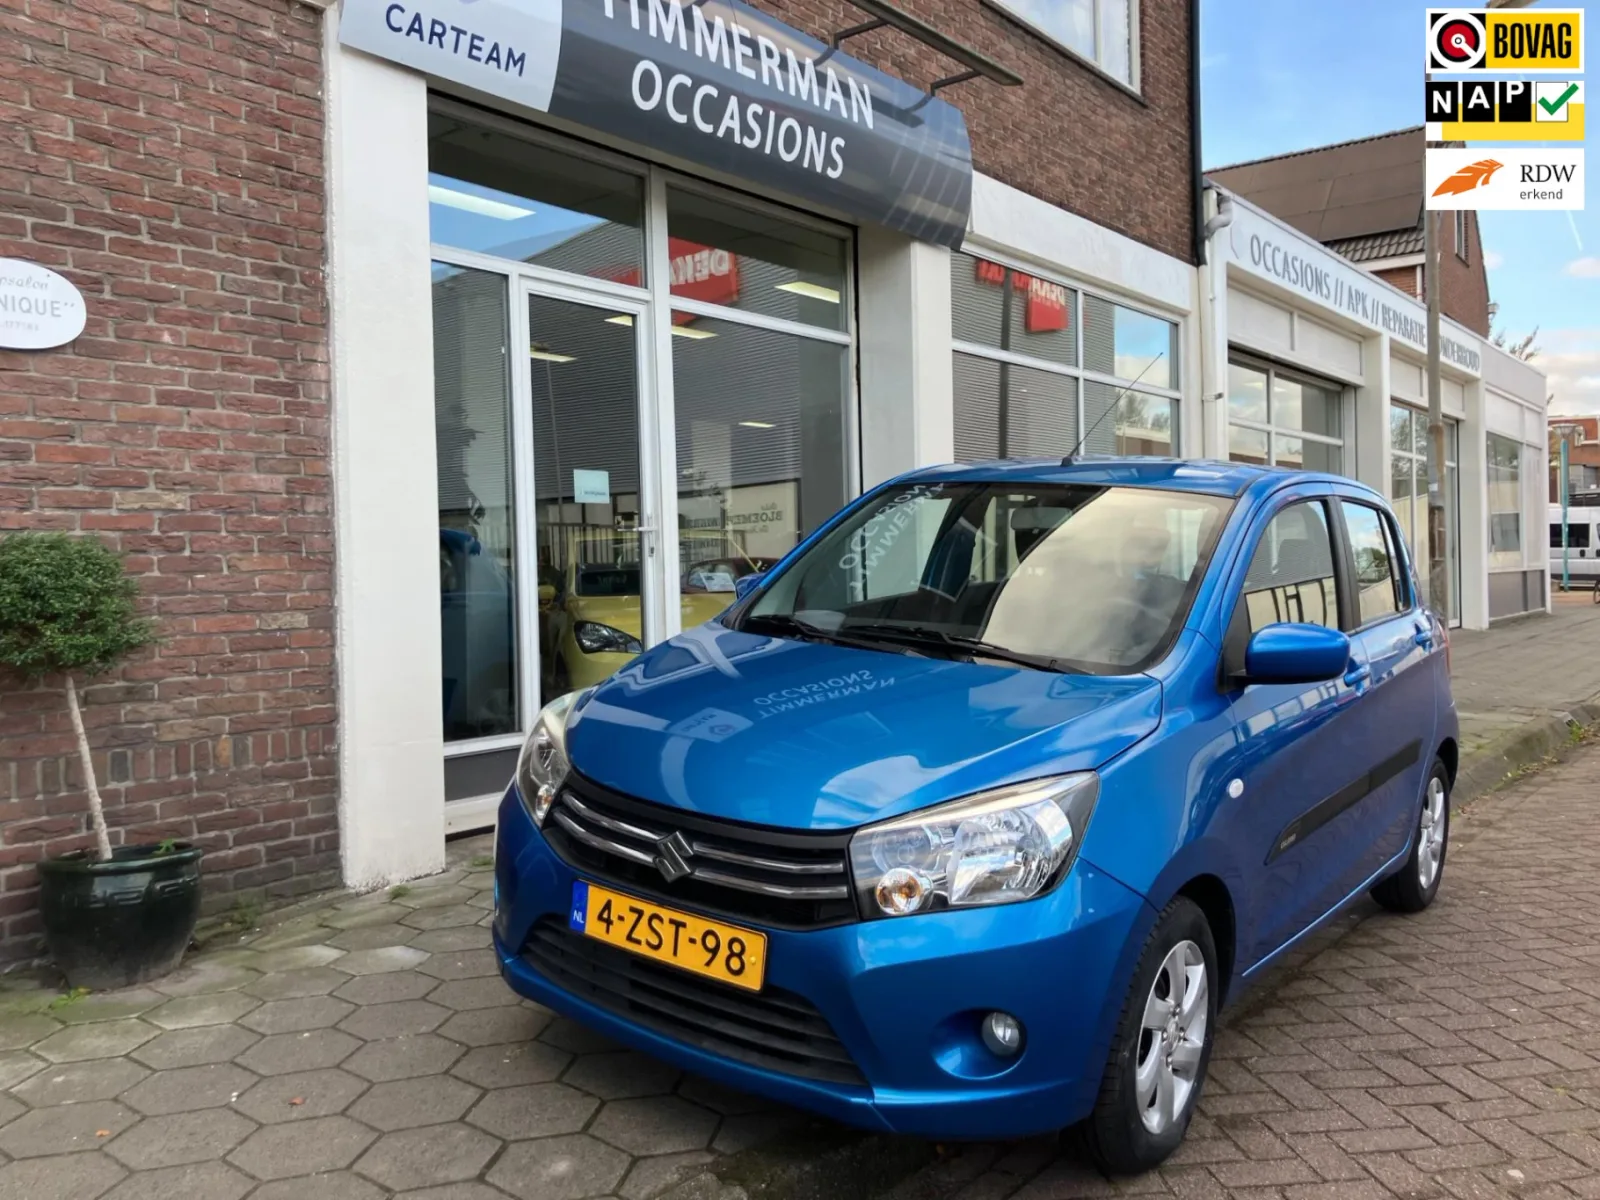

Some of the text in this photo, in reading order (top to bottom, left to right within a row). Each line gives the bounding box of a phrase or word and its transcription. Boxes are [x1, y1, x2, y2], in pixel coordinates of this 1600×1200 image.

[385, 3, 526, 77] CARTEAM
[631, 59, 846, 179] OCCASIONS
[1250, 234, 1331, 301] OCCASIONS
[1347, 284, 1369, 320] APK
[1381, 303, 1427, 349] REPARATIE
[572, 898, 747, 977] NL 4-ZST-98
